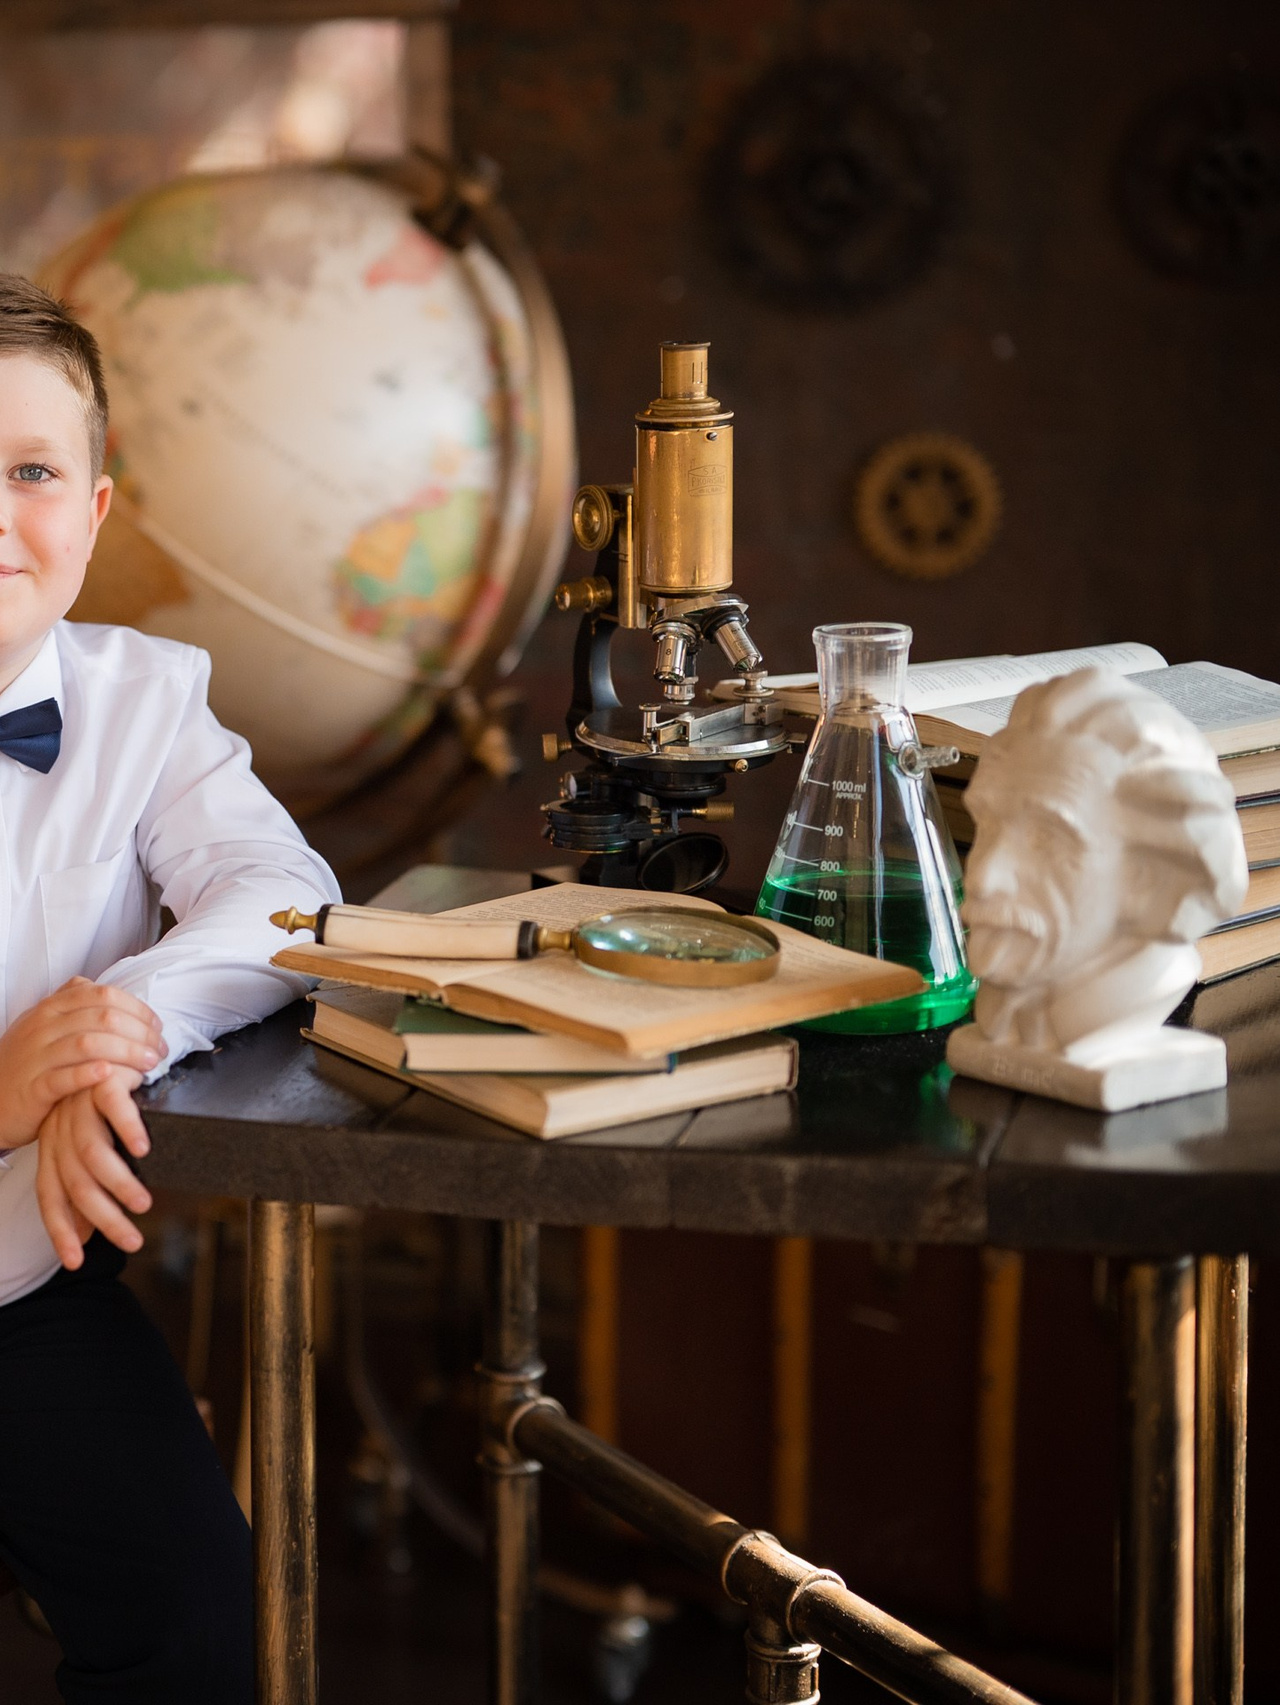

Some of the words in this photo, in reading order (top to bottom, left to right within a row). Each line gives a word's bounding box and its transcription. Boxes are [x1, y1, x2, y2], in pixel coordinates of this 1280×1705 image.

[832, 781, 854, 792] 1000
[854, 783, 867, 793] ml
[824, 825, 844, 837] 900
[820, 861, 840, 872] 800
[817, 889, 837, 901] 700
[814, 915, 835, 927] 600
